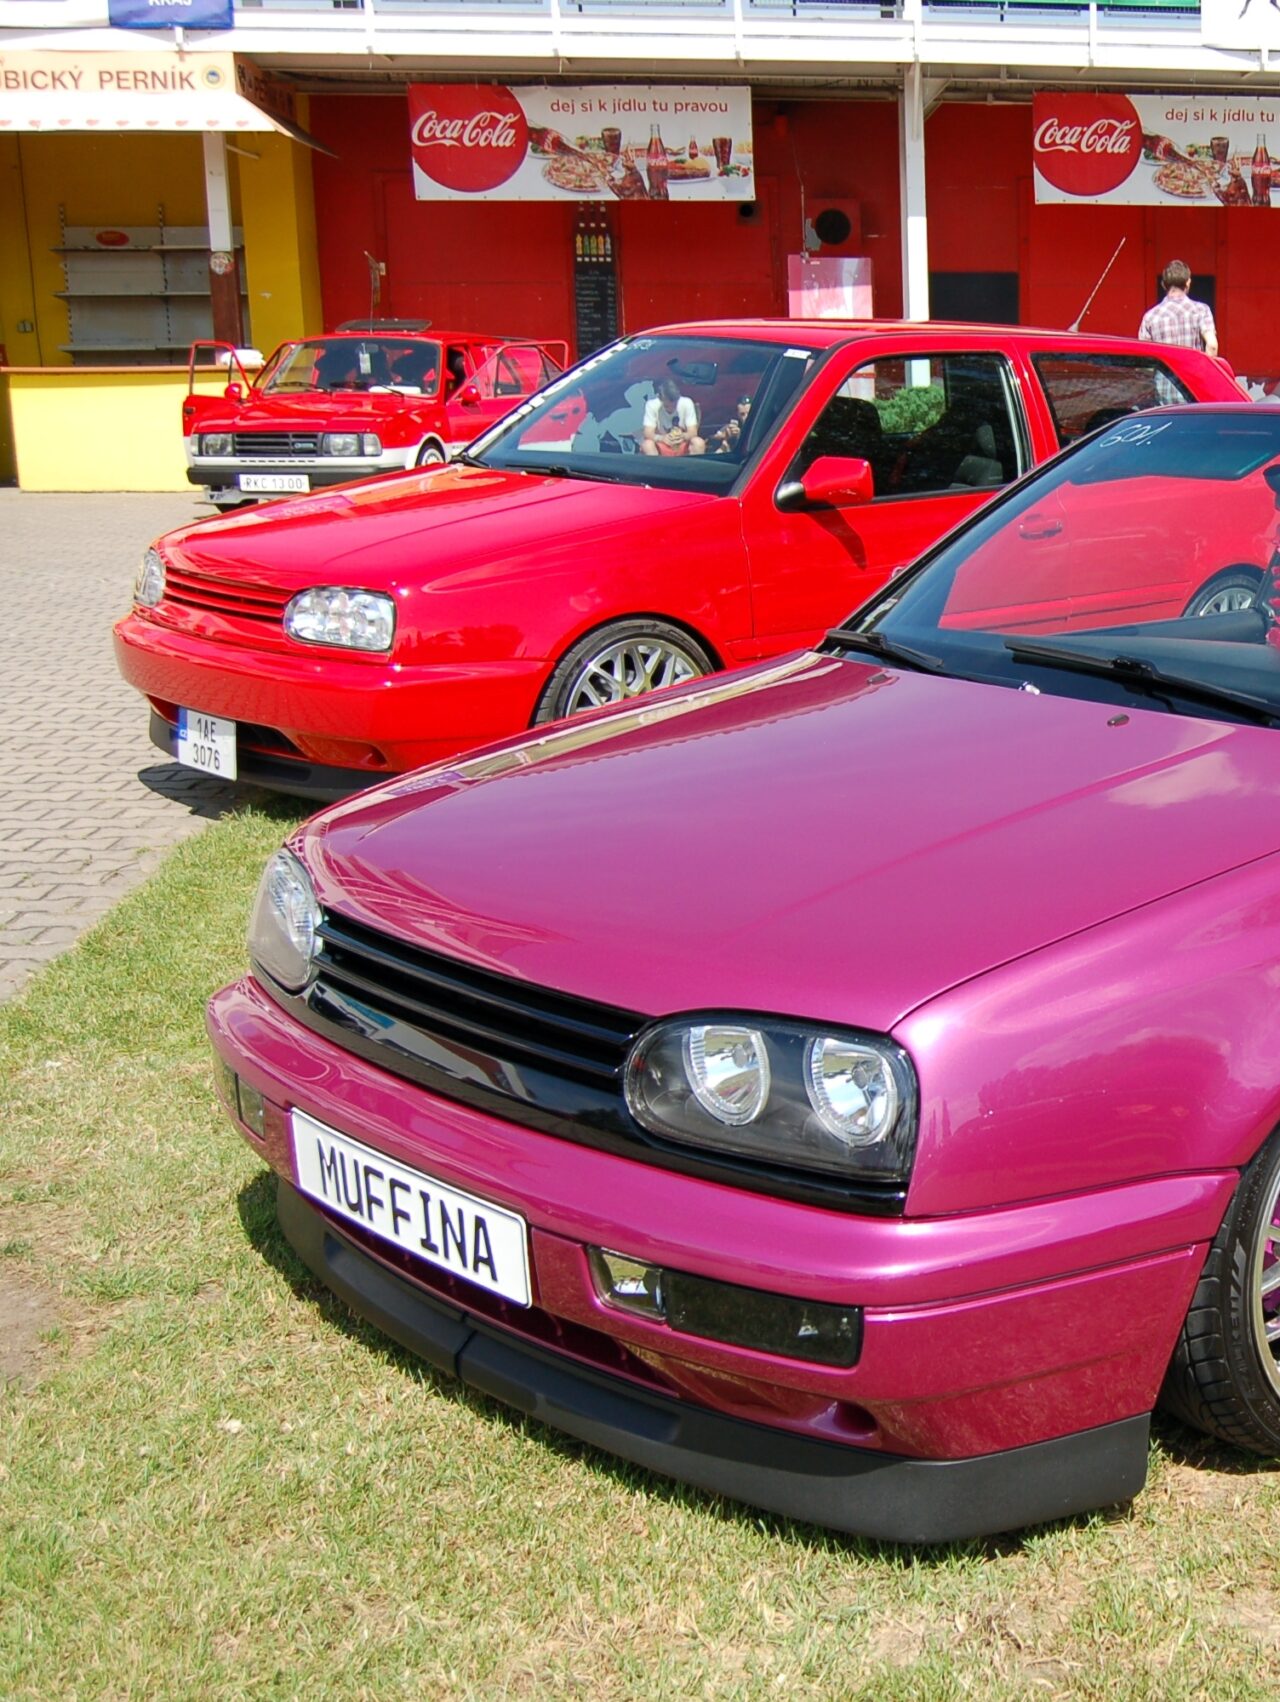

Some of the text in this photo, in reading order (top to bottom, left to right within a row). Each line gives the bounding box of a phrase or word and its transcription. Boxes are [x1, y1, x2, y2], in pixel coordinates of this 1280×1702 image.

[0, 65, 196, 90] BICKÝ PERNÍK
[550, 99, 729, 114] dej si k jídlu tu pravou
[1165, 109, 1188, 122] dej
[1193, 109, 1205, 121] si
[1209, 109, 1218, 121] k
[1222, 109, 1255, 124] jídlu
[1260, 111, 1275, 122] tu
[411, 110, 521, 148] Coca-Cola
[1034, 117, 1136, 154] Coca-Cola
[245, 477, 268, 489] RKC
[197, 718, 217, 743] 1AE
[193, 743, 221, 771] 3076
[316, 1136, 498, 1282] MUFFINA
